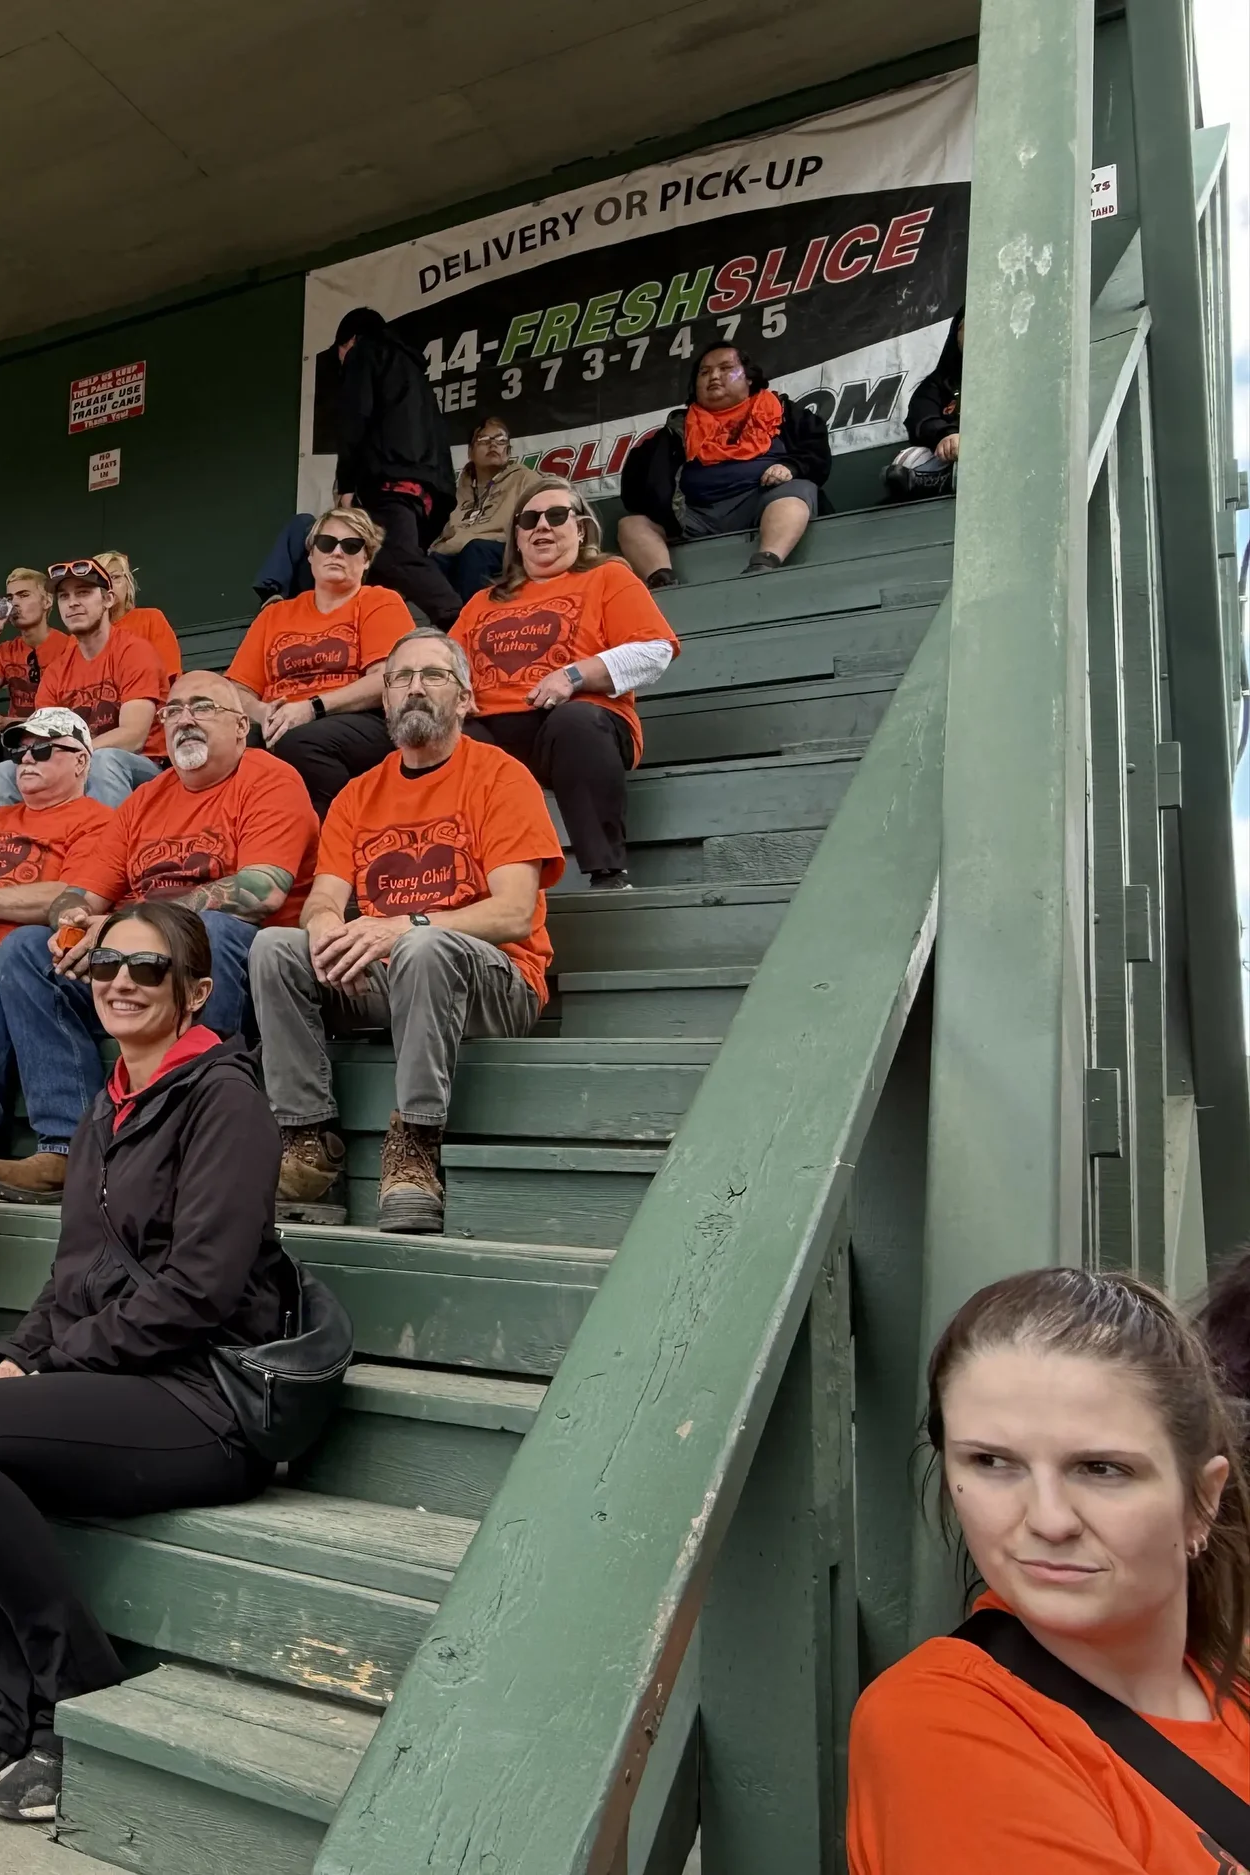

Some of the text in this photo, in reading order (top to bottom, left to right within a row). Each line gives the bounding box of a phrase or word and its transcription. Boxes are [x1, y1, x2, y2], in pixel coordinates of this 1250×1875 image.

[1091, 180, 1111, 194] TS
[418, 155, 823, 294] DELIVERY OR PICK-UP
[90, 381, 114, 394] PARK
[73, 384, 141, 411] PLEASE USE
[72, 394, 141, 421] TRASH CANS
[486, 623, 552, 642] Every Child
[493, 641, 538, 655] Matters
[283, 650, 342, 670] Every Child
[378, 874, 418, 890] Every
[386, 891, 441, 905] Matters
